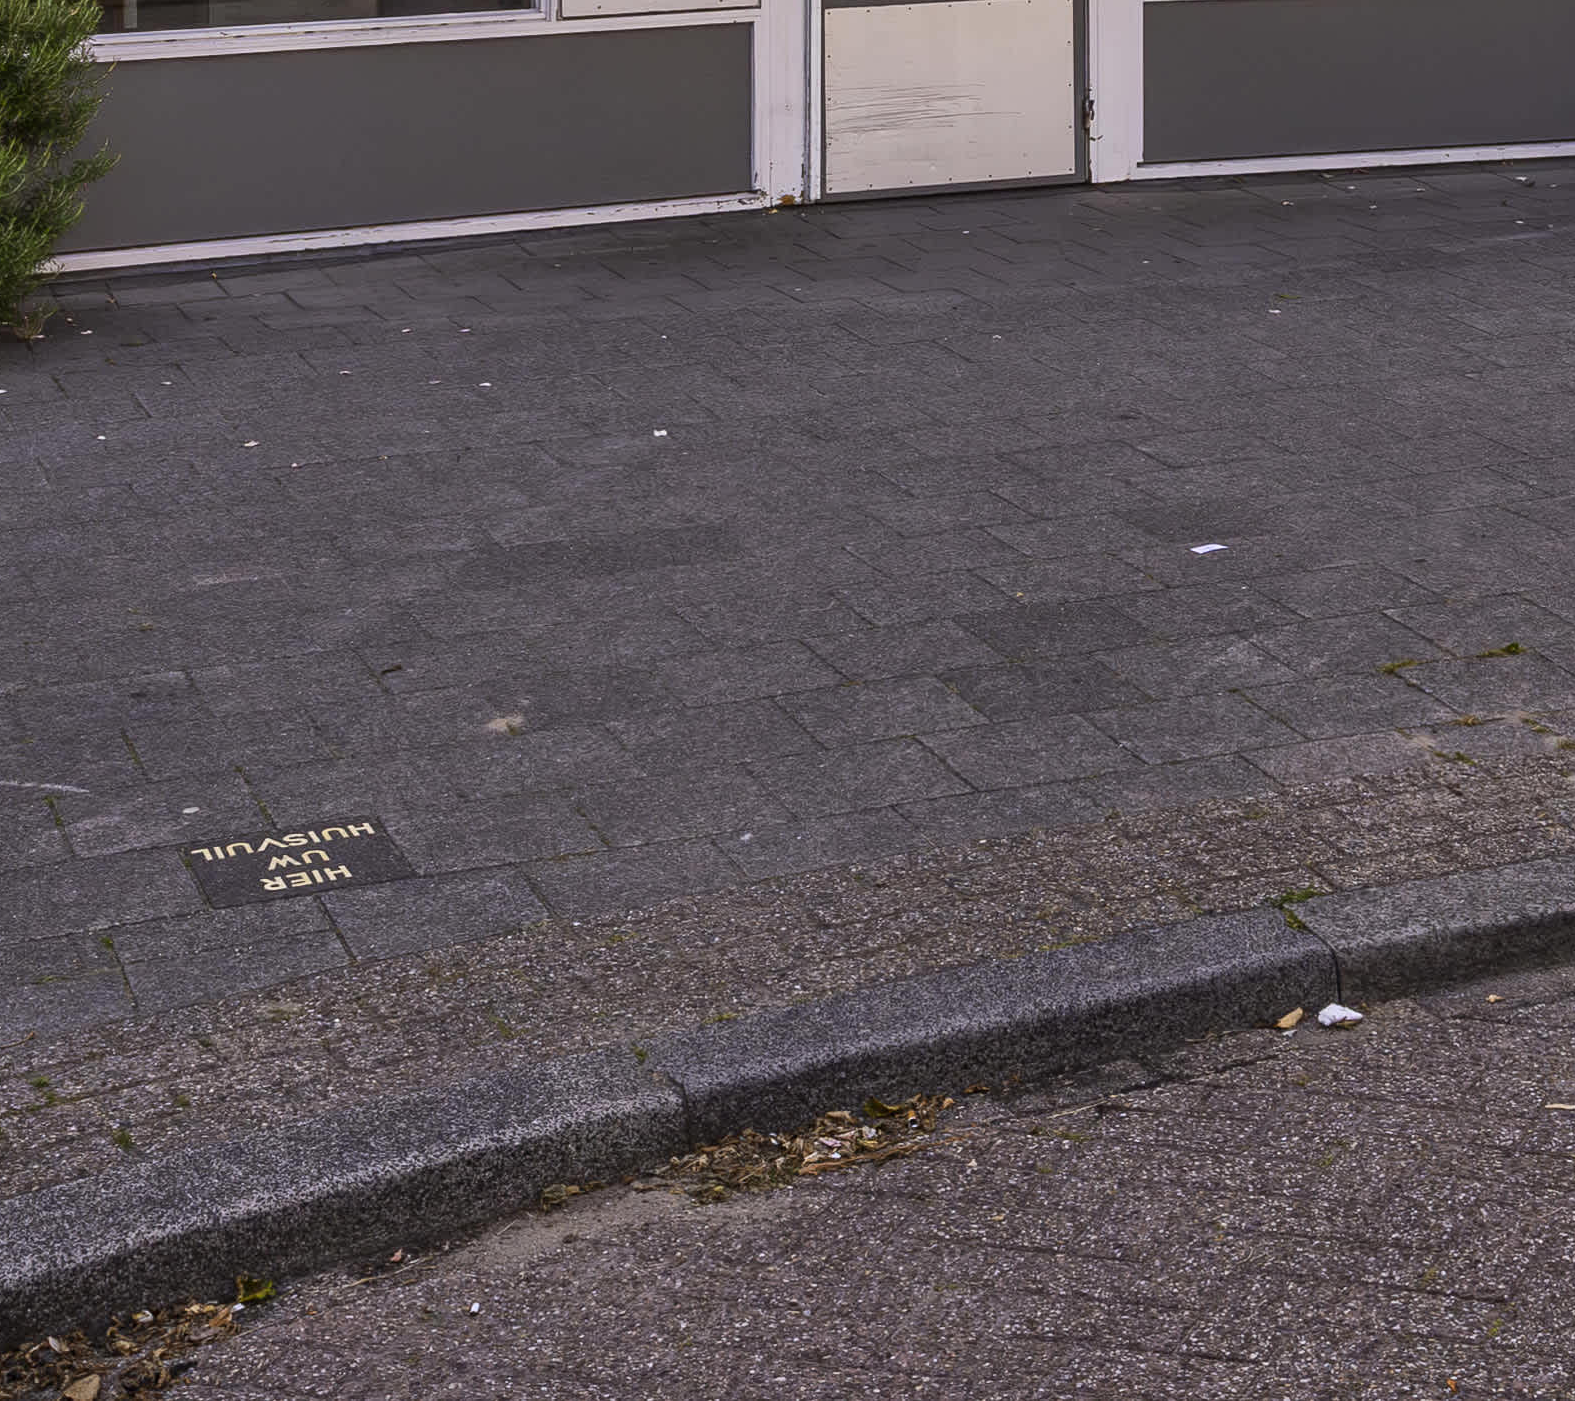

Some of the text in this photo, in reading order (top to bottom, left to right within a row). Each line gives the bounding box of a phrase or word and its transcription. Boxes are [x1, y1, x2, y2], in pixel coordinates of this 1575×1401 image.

[190, 822, 375, 861] HUISVUIL
[268, 849, 330, 871] UW
[259, 865, 353, 891] HIER
